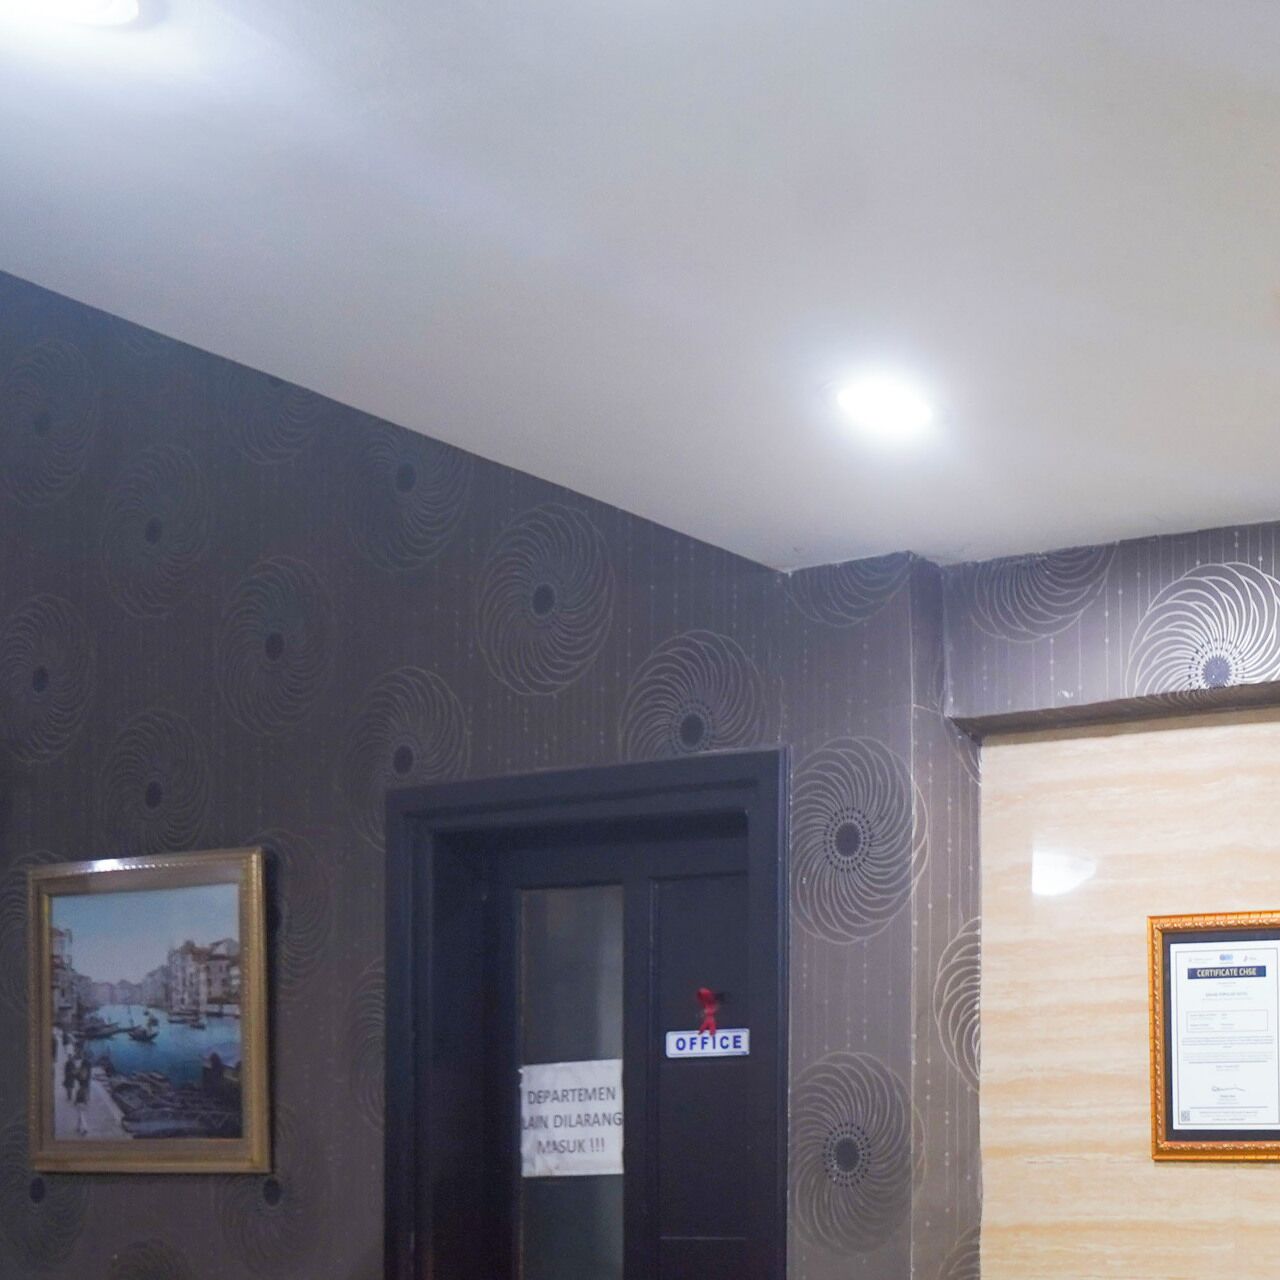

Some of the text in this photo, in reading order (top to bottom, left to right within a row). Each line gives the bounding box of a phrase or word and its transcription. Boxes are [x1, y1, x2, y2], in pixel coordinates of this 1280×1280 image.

[1197, 968, 1238, 977] CERTIFICATE
[676, 1035, 742, 1051] OFFICE
[527, 1087, 616, 1105] DEPARTEMEN
[553, 1111, 623, 1129] DILARANG
[537, 1137, 605, 1154] MASUK !!!
